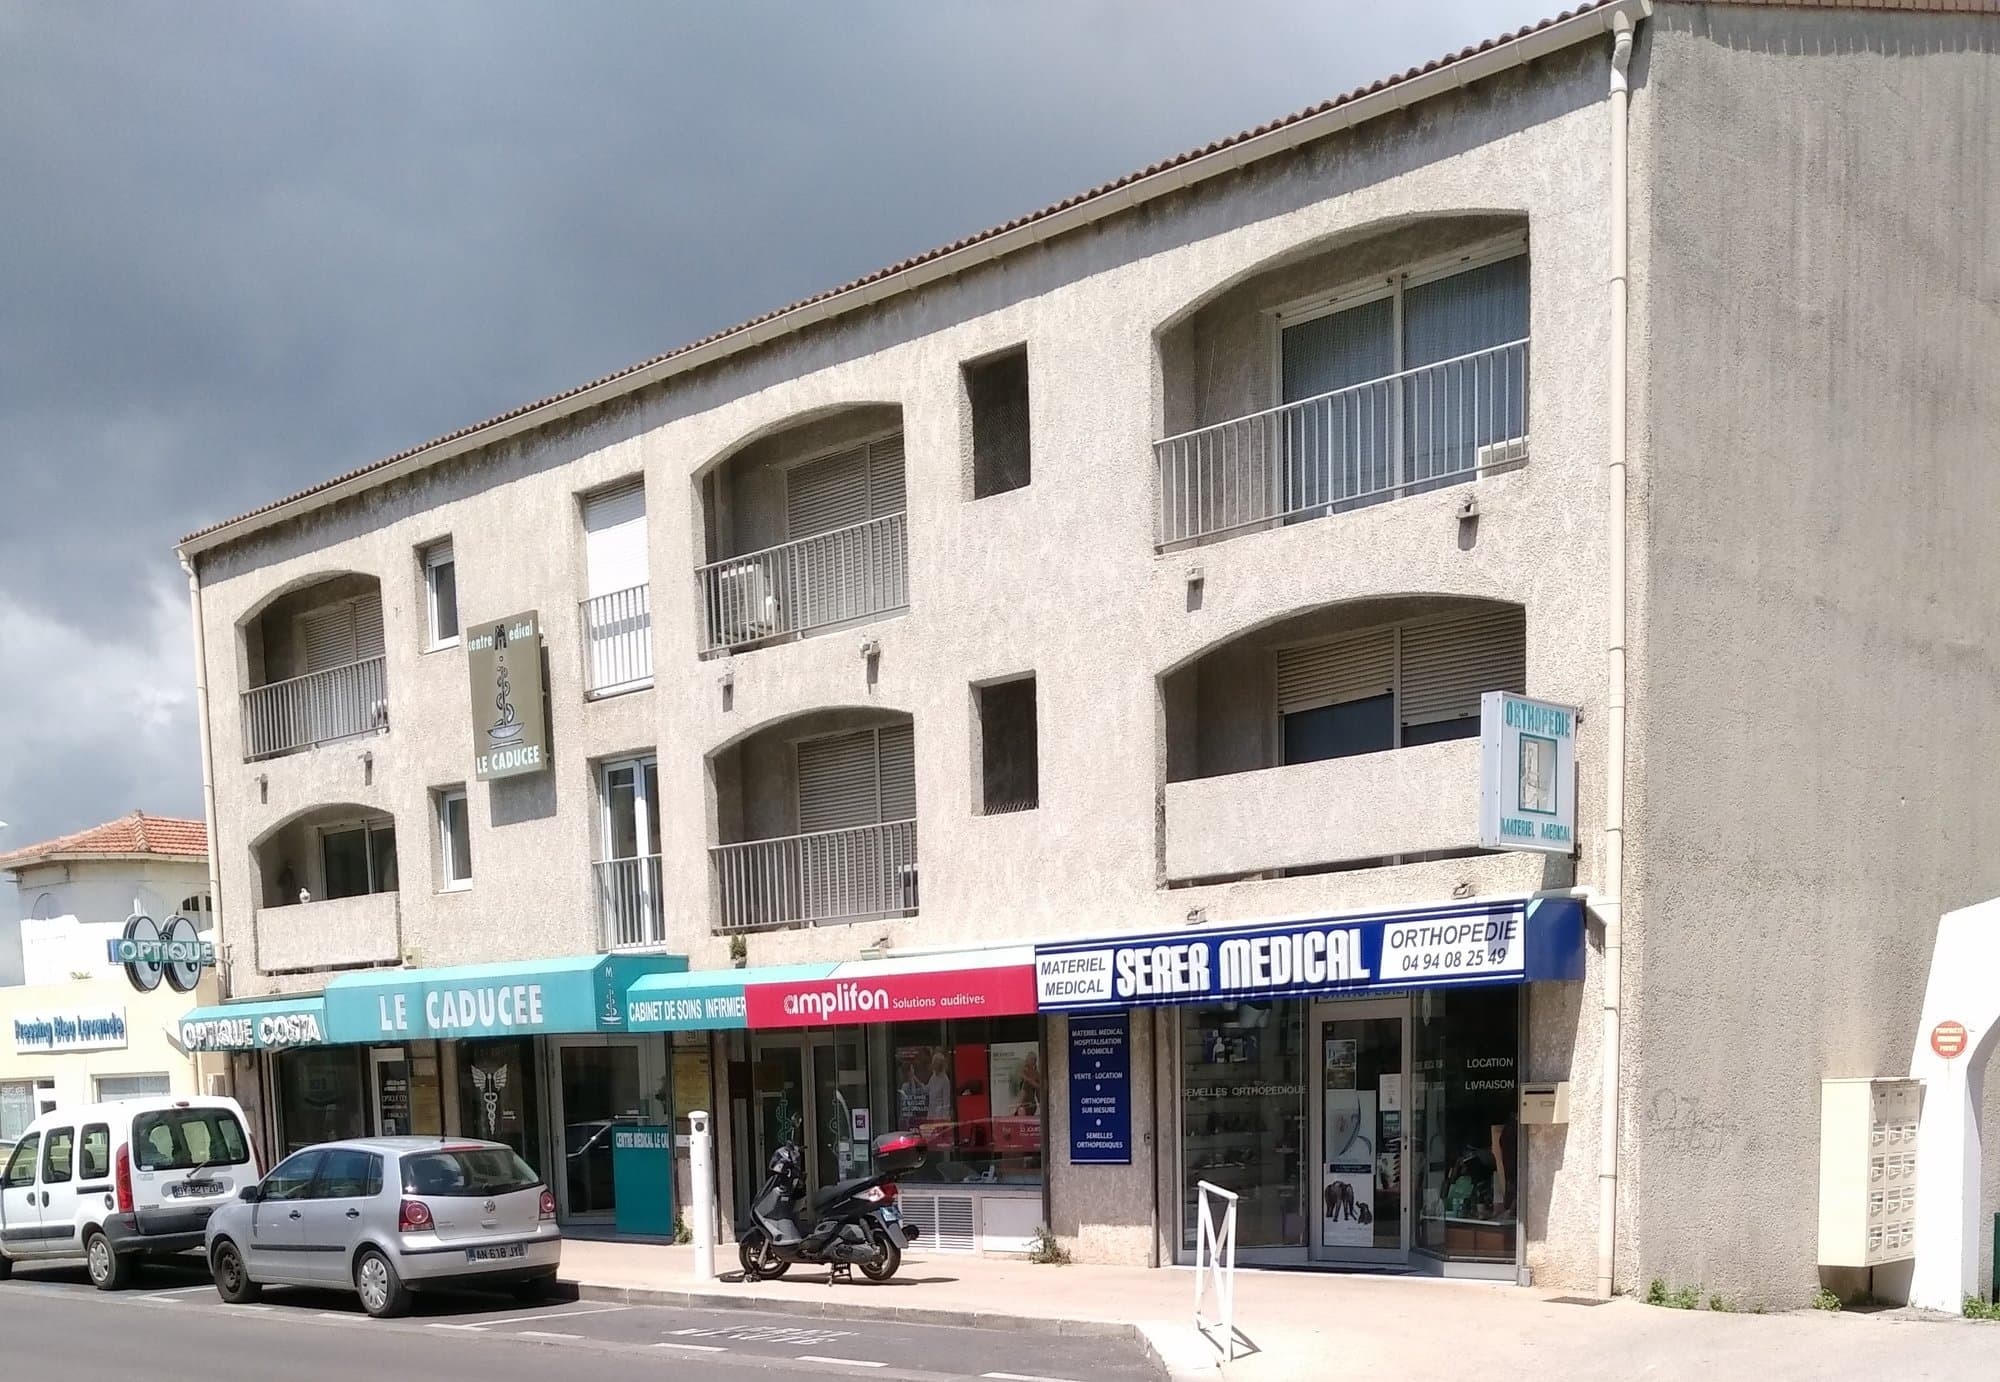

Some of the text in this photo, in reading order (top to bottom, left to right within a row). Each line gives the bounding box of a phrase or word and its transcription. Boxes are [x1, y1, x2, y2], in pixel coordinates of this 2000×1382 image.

[1506, 701, 1571, 737] ORTHOPEDIE
[476, 745, 540, 774] LE CADUCEE
[1501, 817, 1571, 842] MATERIEL MEDICAL
[1391, 920, 1518, 949] ORTHOPEDIE
[118, 941, 214, 962] OPTIQUE
[1115, 928, 1371, 998] SERER MEDICAL
[1402, 947, 1507, 972] 04 94 08 25 49
[1040, 957, 1106, 976] MATERIEL
[1044, 979, 1104, 997] MEDICAL
[379, 984, 544, 1032] LE CADUCEE
[629, 1001, 663, 1022] CABINET
[664, 1000, 677, 1021] DE
[677, 999, 701, 1020] SOINS
[784, 982, 985, 1021] amplifon Solutions auditives
[182, 1014, 321, 1049] OPTIQUE COSTA
[1466, 1058, 1514, 1069] LOCATION
[1095, 1072, 1123, 1080] LOCATION
[1465, 1080, 1515, 1090] LIVRAISON
[1080, 1097, 1116, 1105] ORTHOPEDIE
[1076, 1141, 1123, 1149] ORTHOPEDIQUES
[1086, 1131, 1113, 1139] SEMELLES
